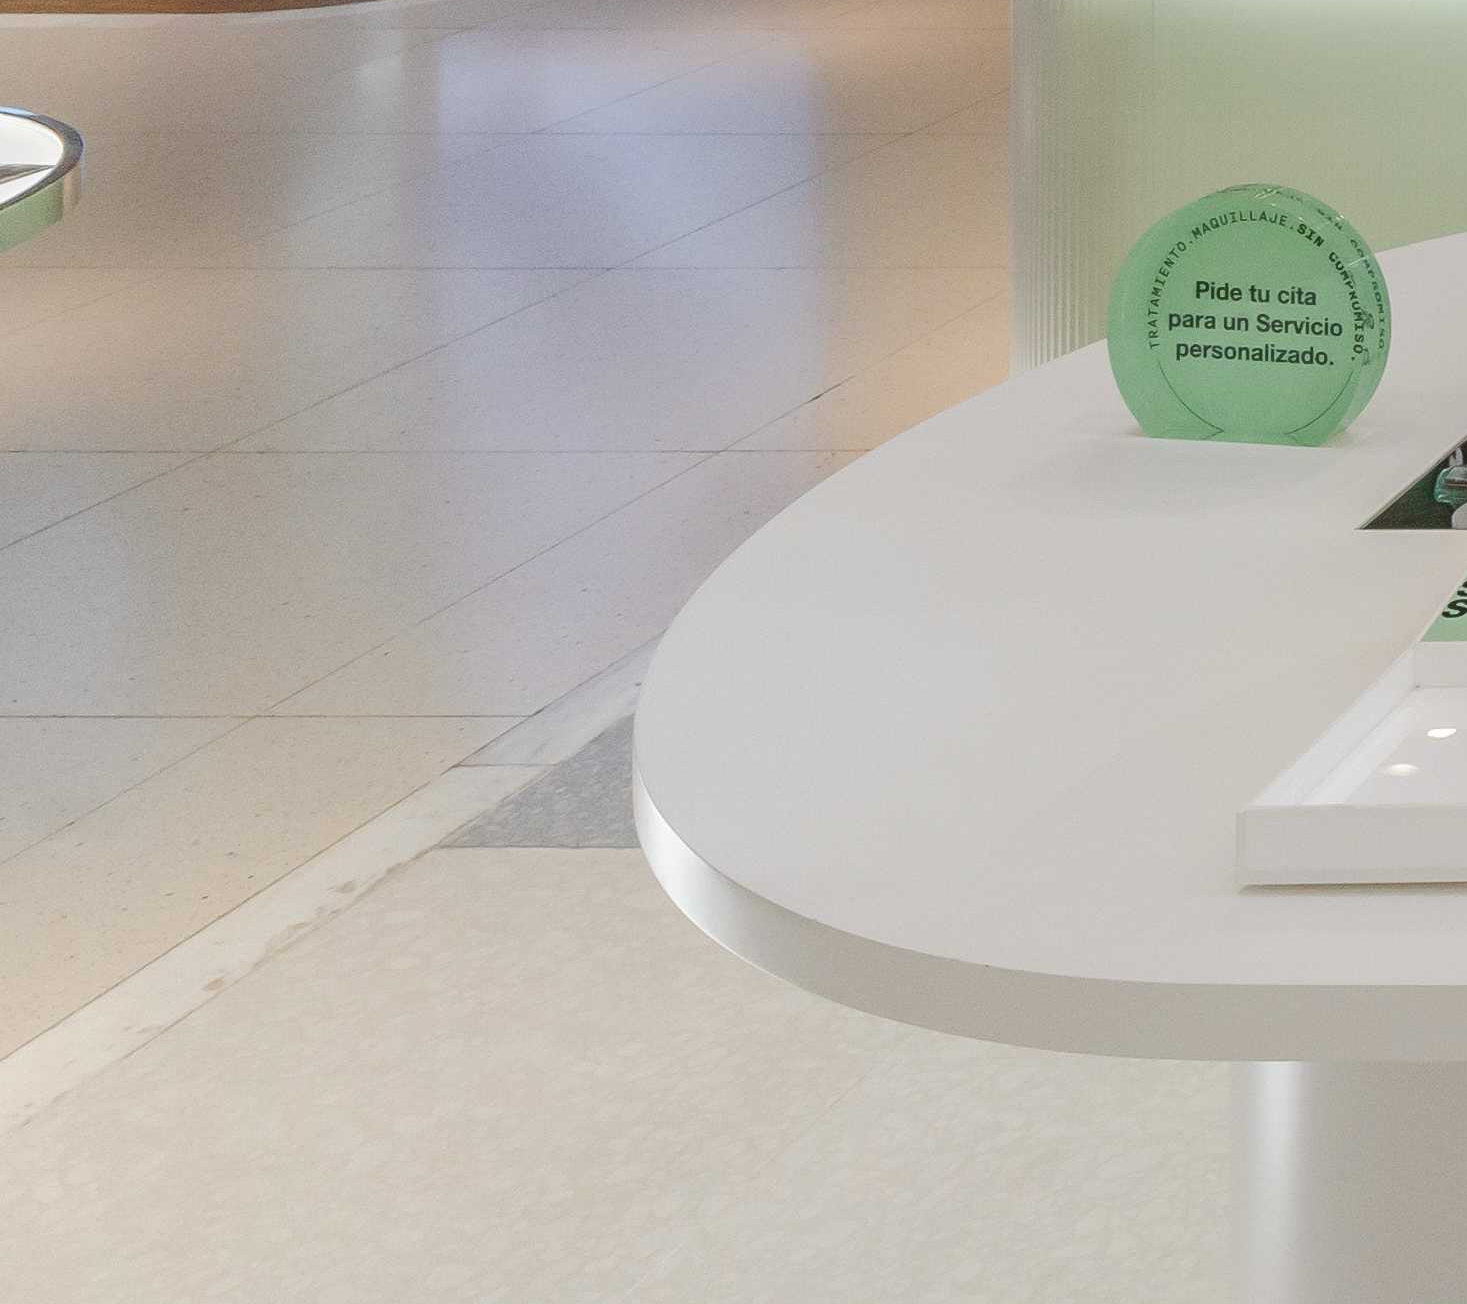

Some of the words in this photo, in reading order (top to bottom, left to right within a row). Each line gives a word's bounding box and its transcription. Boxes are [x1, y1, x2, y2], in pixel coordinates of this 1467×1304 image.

[1296, 223, 1325, 248] SIN
[1195, 281, 1242, 302] Pide
[1249, 284, 1270, 304] tu
[1277, 283, 1317, 306] cita
[1168, 312, 1216, 331] para
[1223, 313, 1249, 331] un
[1256, 313, 1343, 337] Servicio
[1176, 341, 1335, 366] personalizado.
